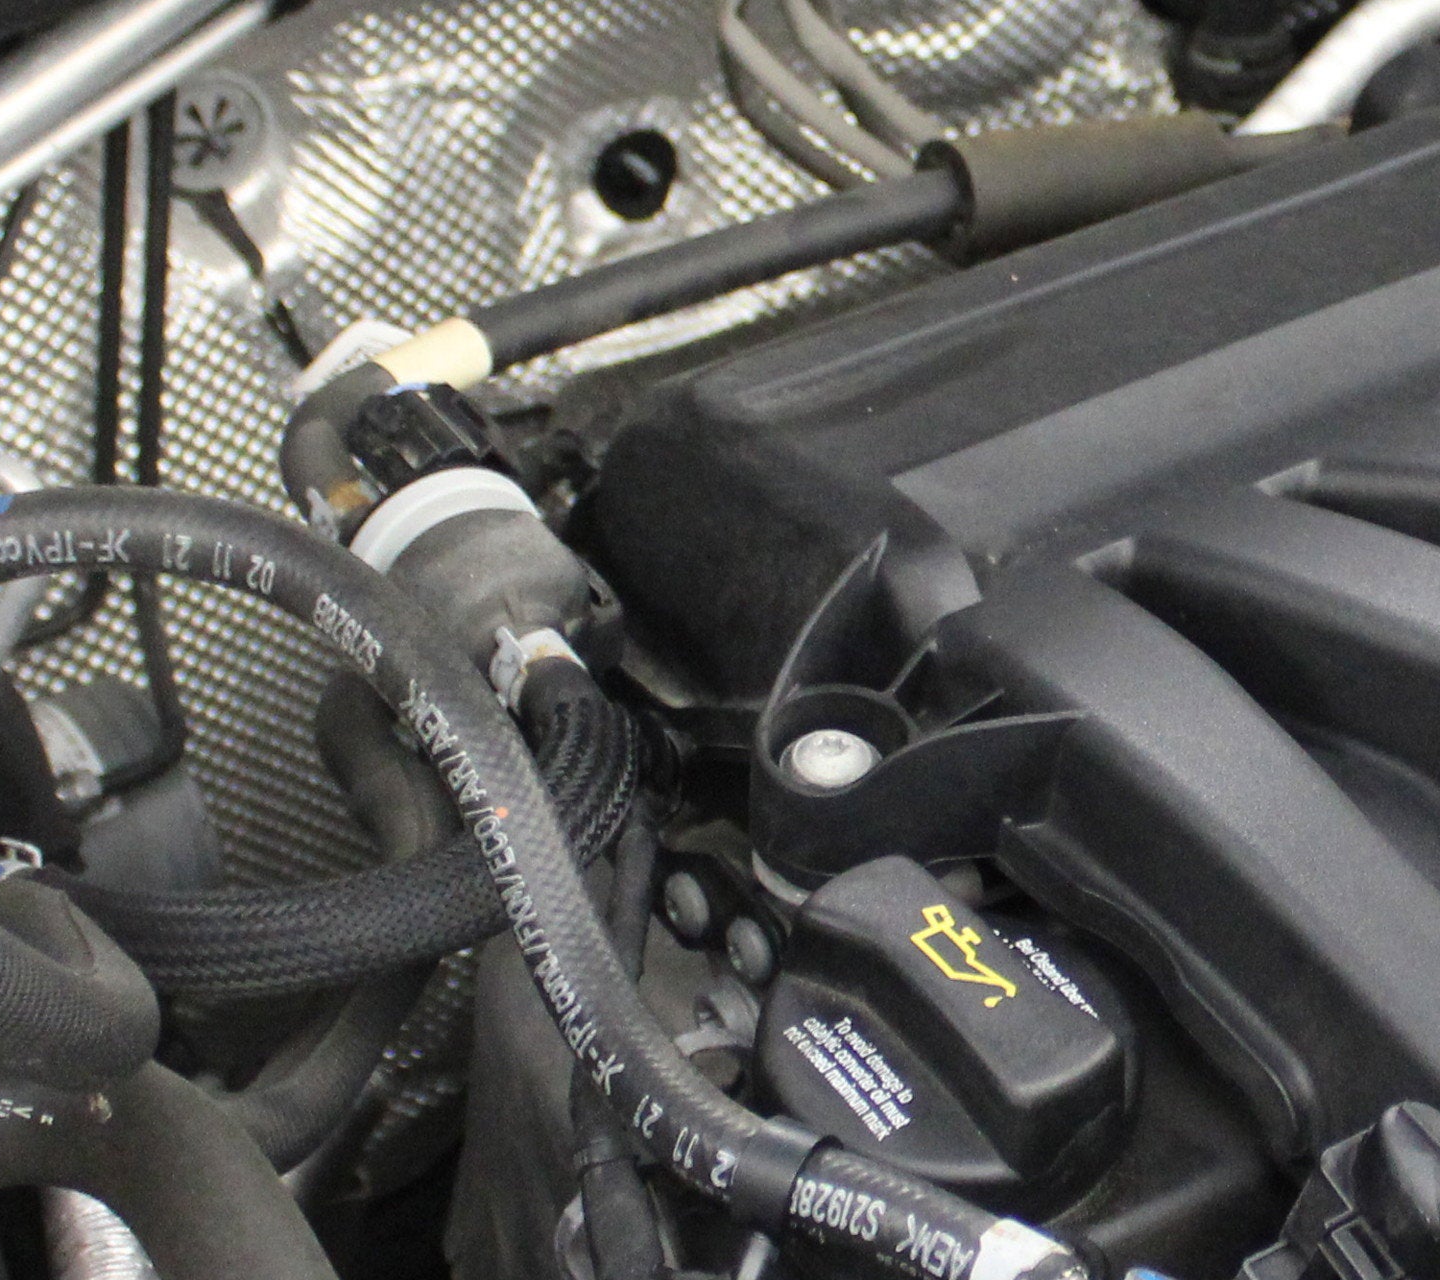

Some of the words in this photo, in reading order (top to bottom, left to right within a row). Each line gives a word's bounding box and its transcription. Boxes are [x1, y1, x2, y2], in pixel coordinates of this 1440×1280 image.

[161, 532, 193, 571] 21
[246, 554, 276, 595] 02
[803, 1017, 842, 1054] catalytic
[834, 1016, 852, 1036] To
[843, 1031, 878, 1059] avoid
[865, 1053, 905, 1094] damage
[896, 1088, 914, 1105] to
[834, 1048, 879, 1093] converter
[782, 1025, 809, 1046] not
[796, 1039, 838, 1075] exceed
[824, 1068, 871, 1117] maximum
[861, 1110, 893, 1142] mark
[869, 1088, 892, 1106] oil
[880, 1100, 912, 1130] must
[711, 1150, 741, 1189] 2
